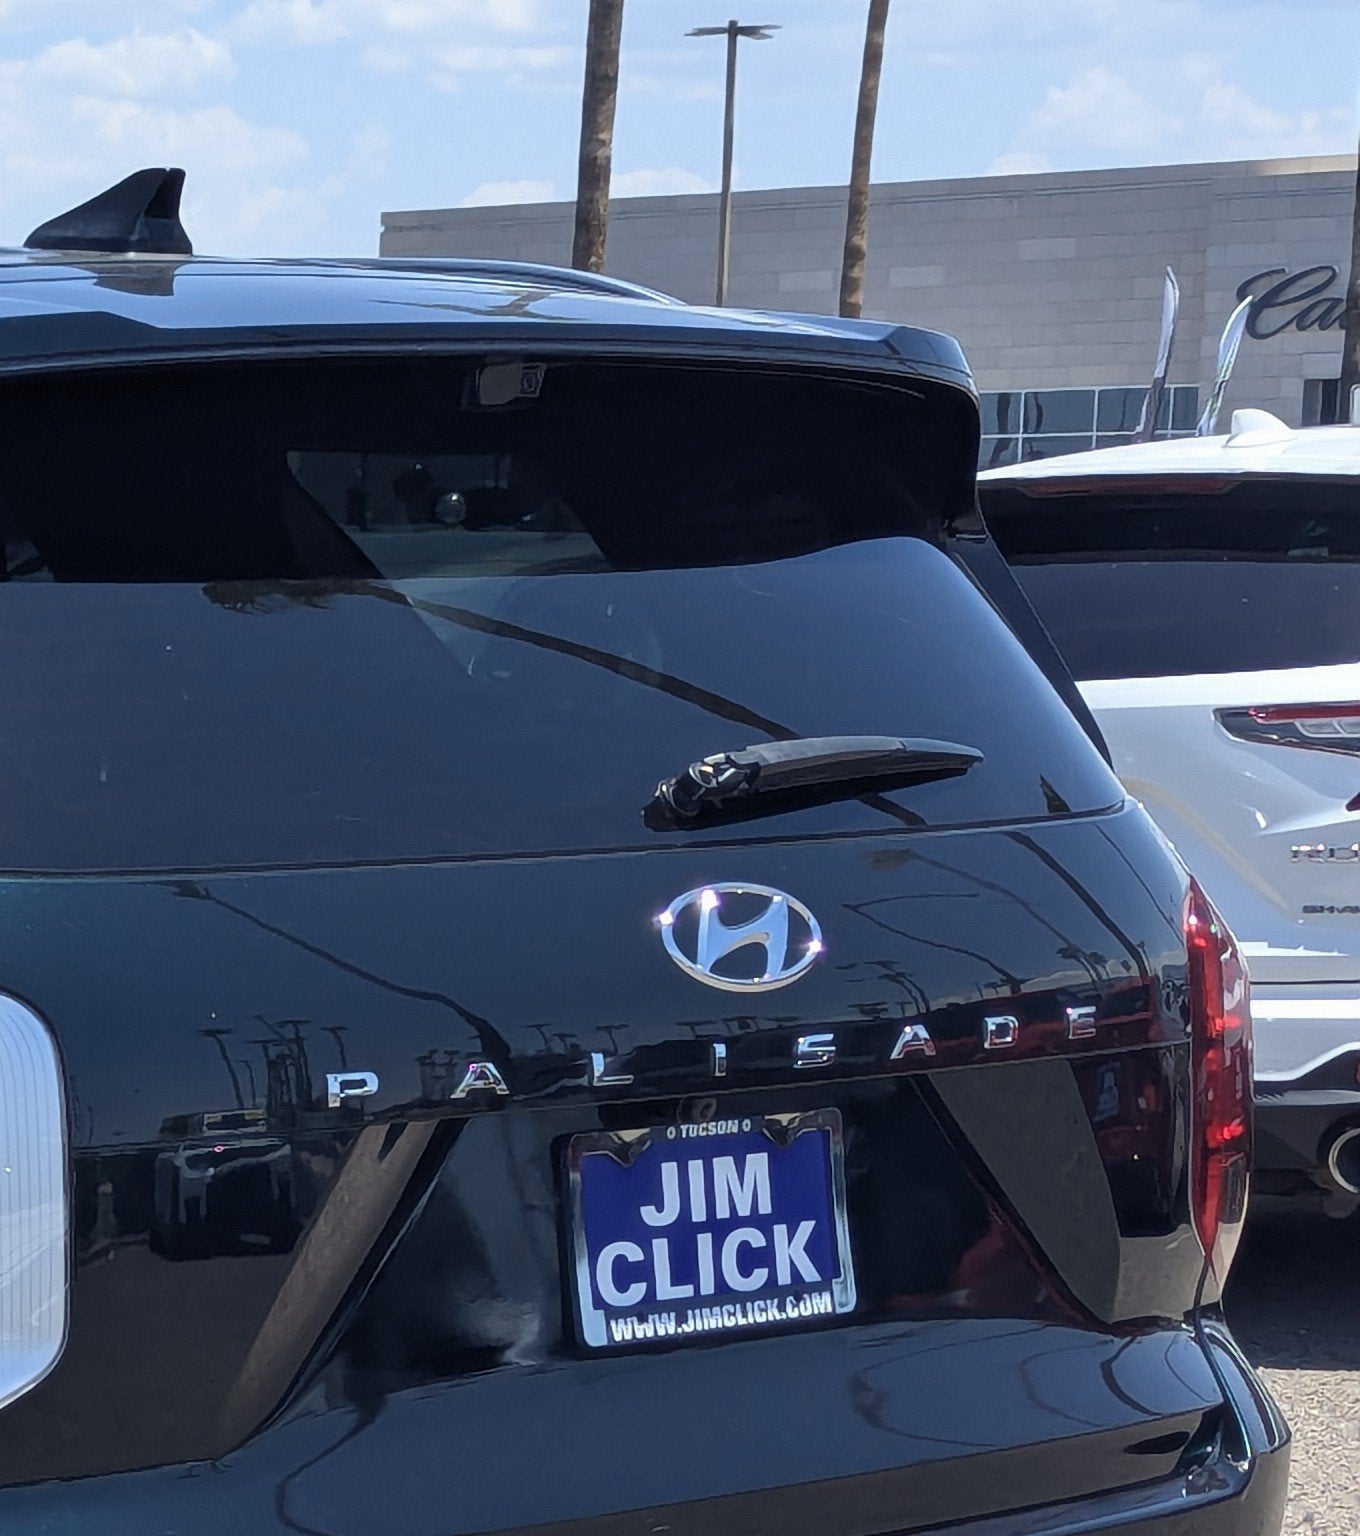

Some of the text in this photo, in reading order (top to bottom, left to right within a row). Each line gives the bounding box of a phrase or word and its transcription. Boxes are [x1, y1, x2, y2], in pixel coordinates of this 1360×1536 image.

[1236, 265, 1347, 340] Ca
[325, 1004, 1098, 1108] PALISADE
[679, 1118, 739, 1139] TUCSON
[640, 1152, 772, 1227] JIM
[595, 1220, 822, 1307] CLICK
[609, 1289, 834, 1343] WWW.JIMCLICK.COM
